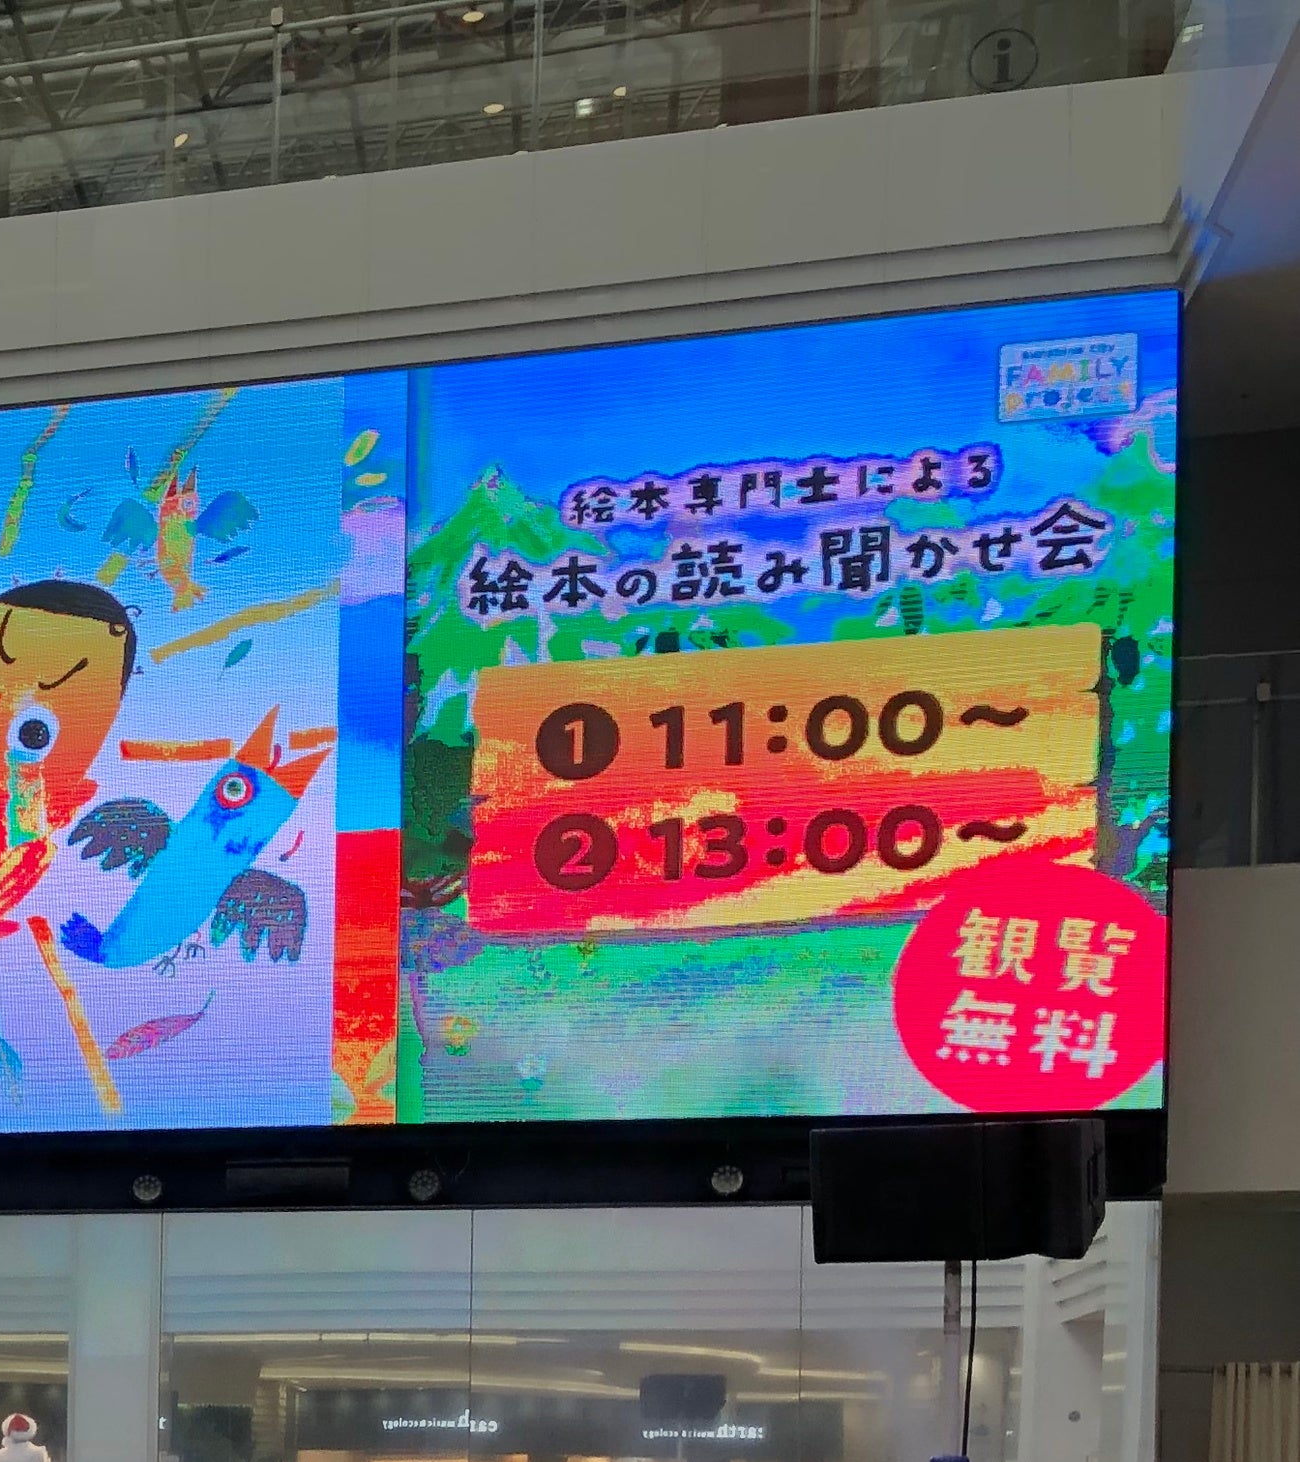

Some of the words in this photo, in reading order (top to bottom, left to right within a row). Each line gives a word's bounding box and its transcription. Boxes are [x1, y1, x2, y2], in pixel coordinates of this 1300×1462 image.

[1006, 356, 1129, 386] FAMILY
[569, 454, 992, 526] 絵本専門士による
[468, 503, 1106, 612] 絵本の読み聞かせ会
[952, 907, 1137, 998] 観覧
[935, 991, 1120, 1079] 無料
